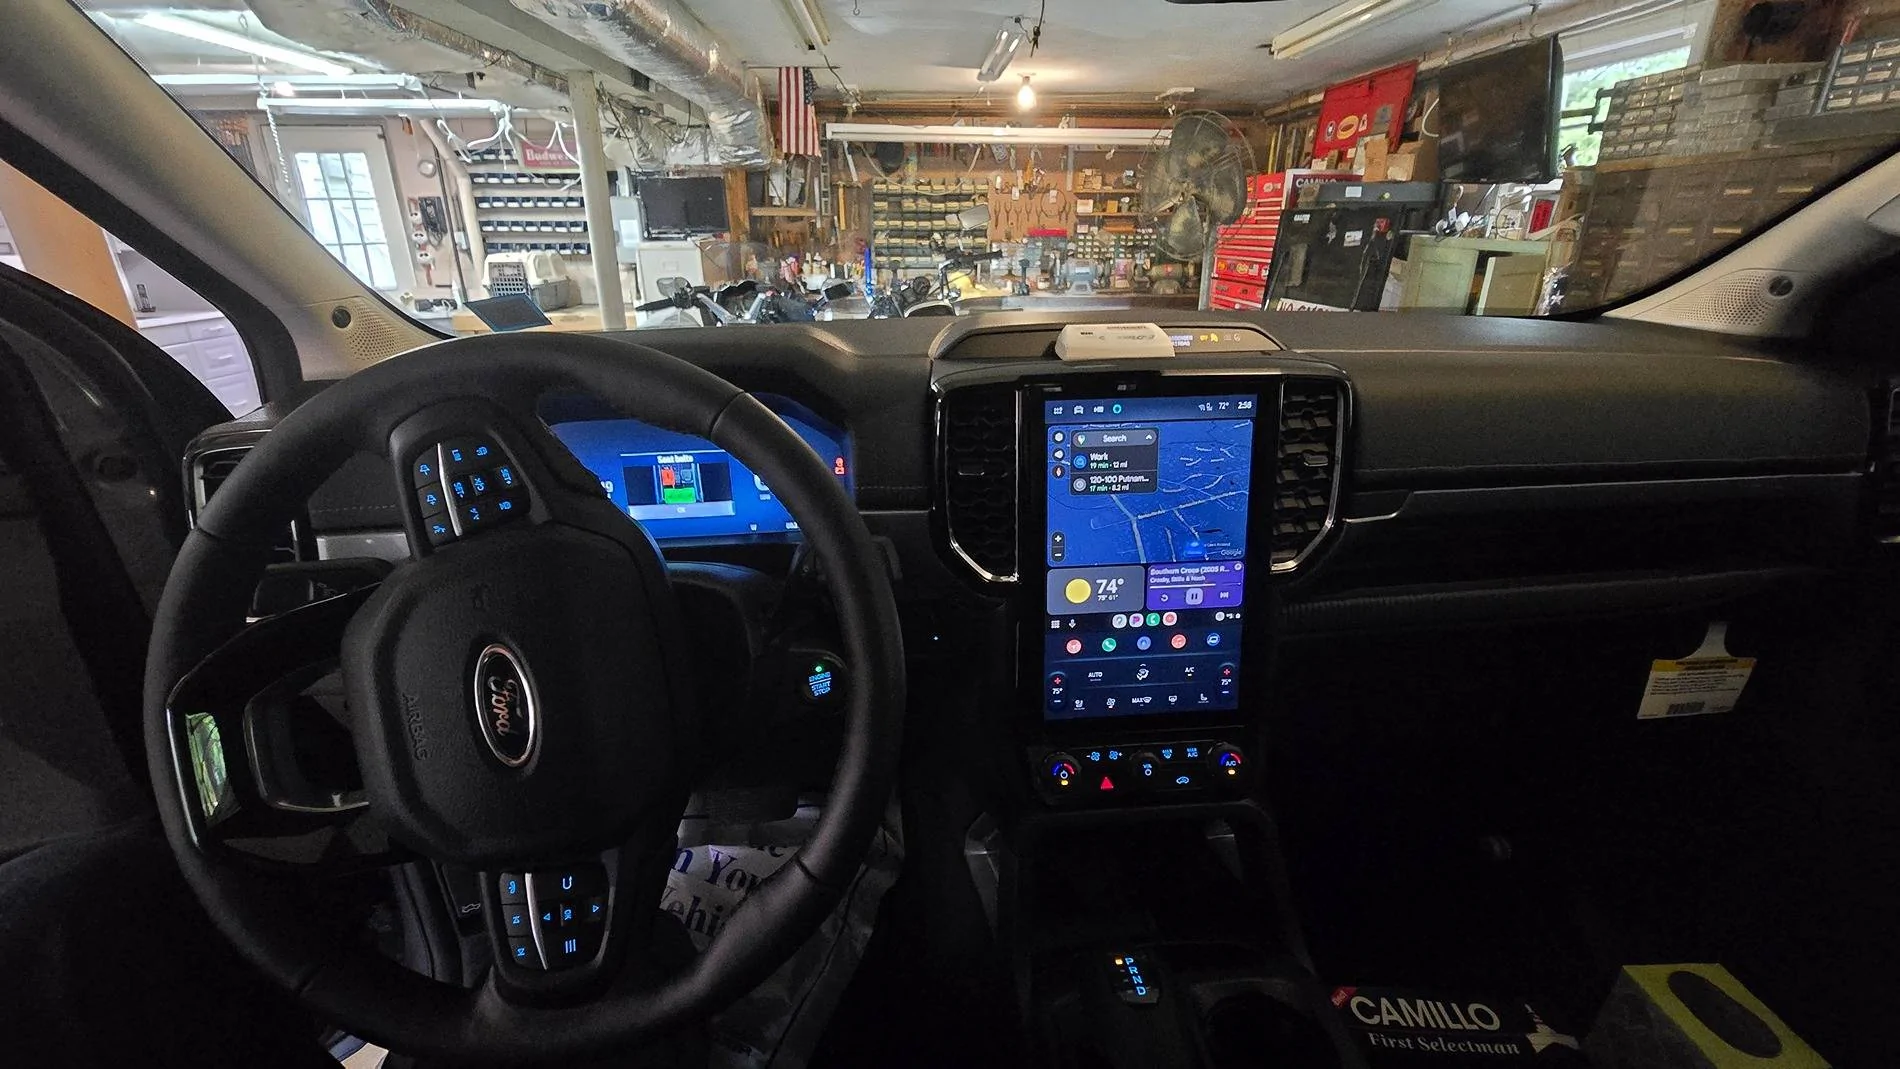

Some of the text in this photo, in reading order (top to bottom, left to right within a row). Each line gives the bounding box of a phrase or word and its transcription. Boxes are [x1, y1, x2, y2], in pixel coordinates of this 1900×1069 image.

[1102, 434, 1127, 443] Search
[656, 454, 694, 464] Seat belts
[1090, 452, 1108, 461] Work
[1097, 461, 1109, 469] min
[1119, 460, 1128, 468] mi
[1096, 484, 1108, 492] min
[1121, 483, 1130, 491] mi
[1220, 548, 1242, 556] Google
[1096, 578, 1125, 594] 74°
[401, 692, 428, 761] AIRBAG
[1124, 957, 1134, 965] P
[1128, 966, 1138, 974] R
[1132, 975, 1143, 984] N
[1136, 986, 1146, 995] D
[1350, 995, 1501, 1031] CAMILLO
[1368, 1032, 1521, 1055] First Selectman
